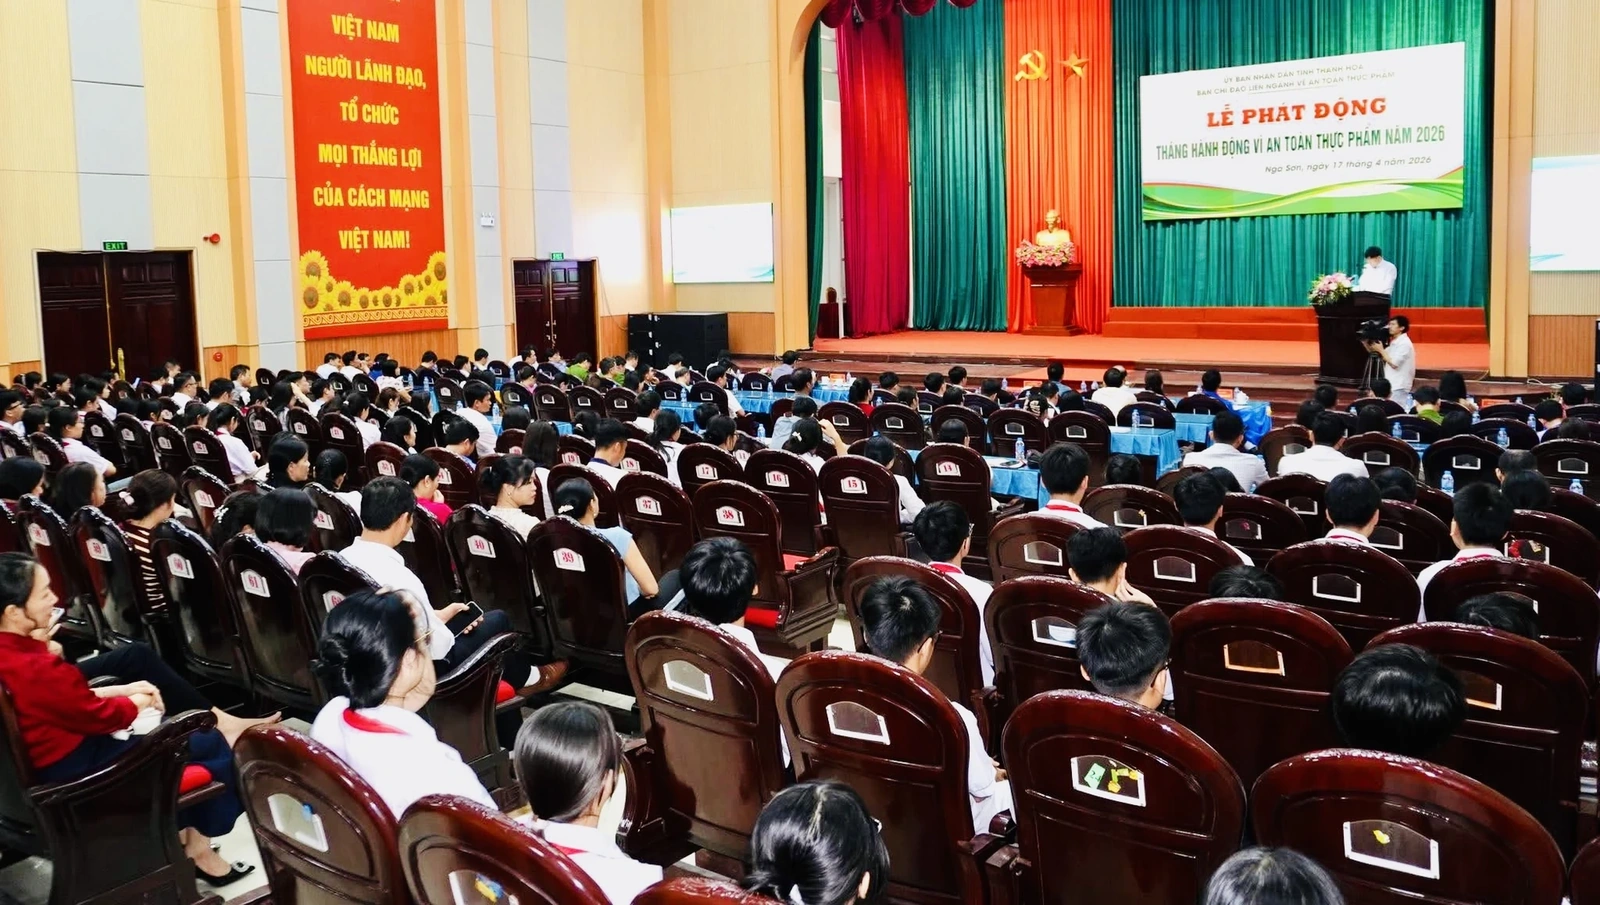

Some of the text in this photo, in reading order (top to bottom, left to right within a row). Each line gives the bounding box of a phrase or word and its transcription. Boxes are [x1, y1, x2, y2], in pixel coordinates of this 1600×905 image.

[331, 13, 400, 43] VIỆT NAM
[305, 54, 426, 90] NGƯỜI LÃNH ĐẠO,
[339, 96, 399, 126] TỔ CHỨC
[1207, 97, 1386, 127] LỄ PHÁT ĐỘNG
[1156, 122, 1445, 160] THÁNG HÀNH ĐỘNG VÌ AN TOÀN THỰC PHẨM NĂM 2026
[318, 139, 422, 171] MỌI THẮNG LỢI
[1265, 165, 1283, 175] Nga
[1333, 161, 1343, 169] 17
[1408, 156, 1432, 165] 2026
[313, 180, 430, 212] CỦA CÁCH MẠNG
[106, 242, 125, 250] EXIT
[338, 226, 410, 253] VIỆT NAM!
[567, 454, 575, 463] 19
[625, 460, 634, 468] 18
[700, 466, 709, 475] 17
[772, 473, 781, 482] 16
[846, 479, 857, 488] 15
[642, 499, 651, 509] 37
[722, 509, 733, 519] 38
[561, 552, 574, 563] 39
[248, 574, 259, 588] 61
